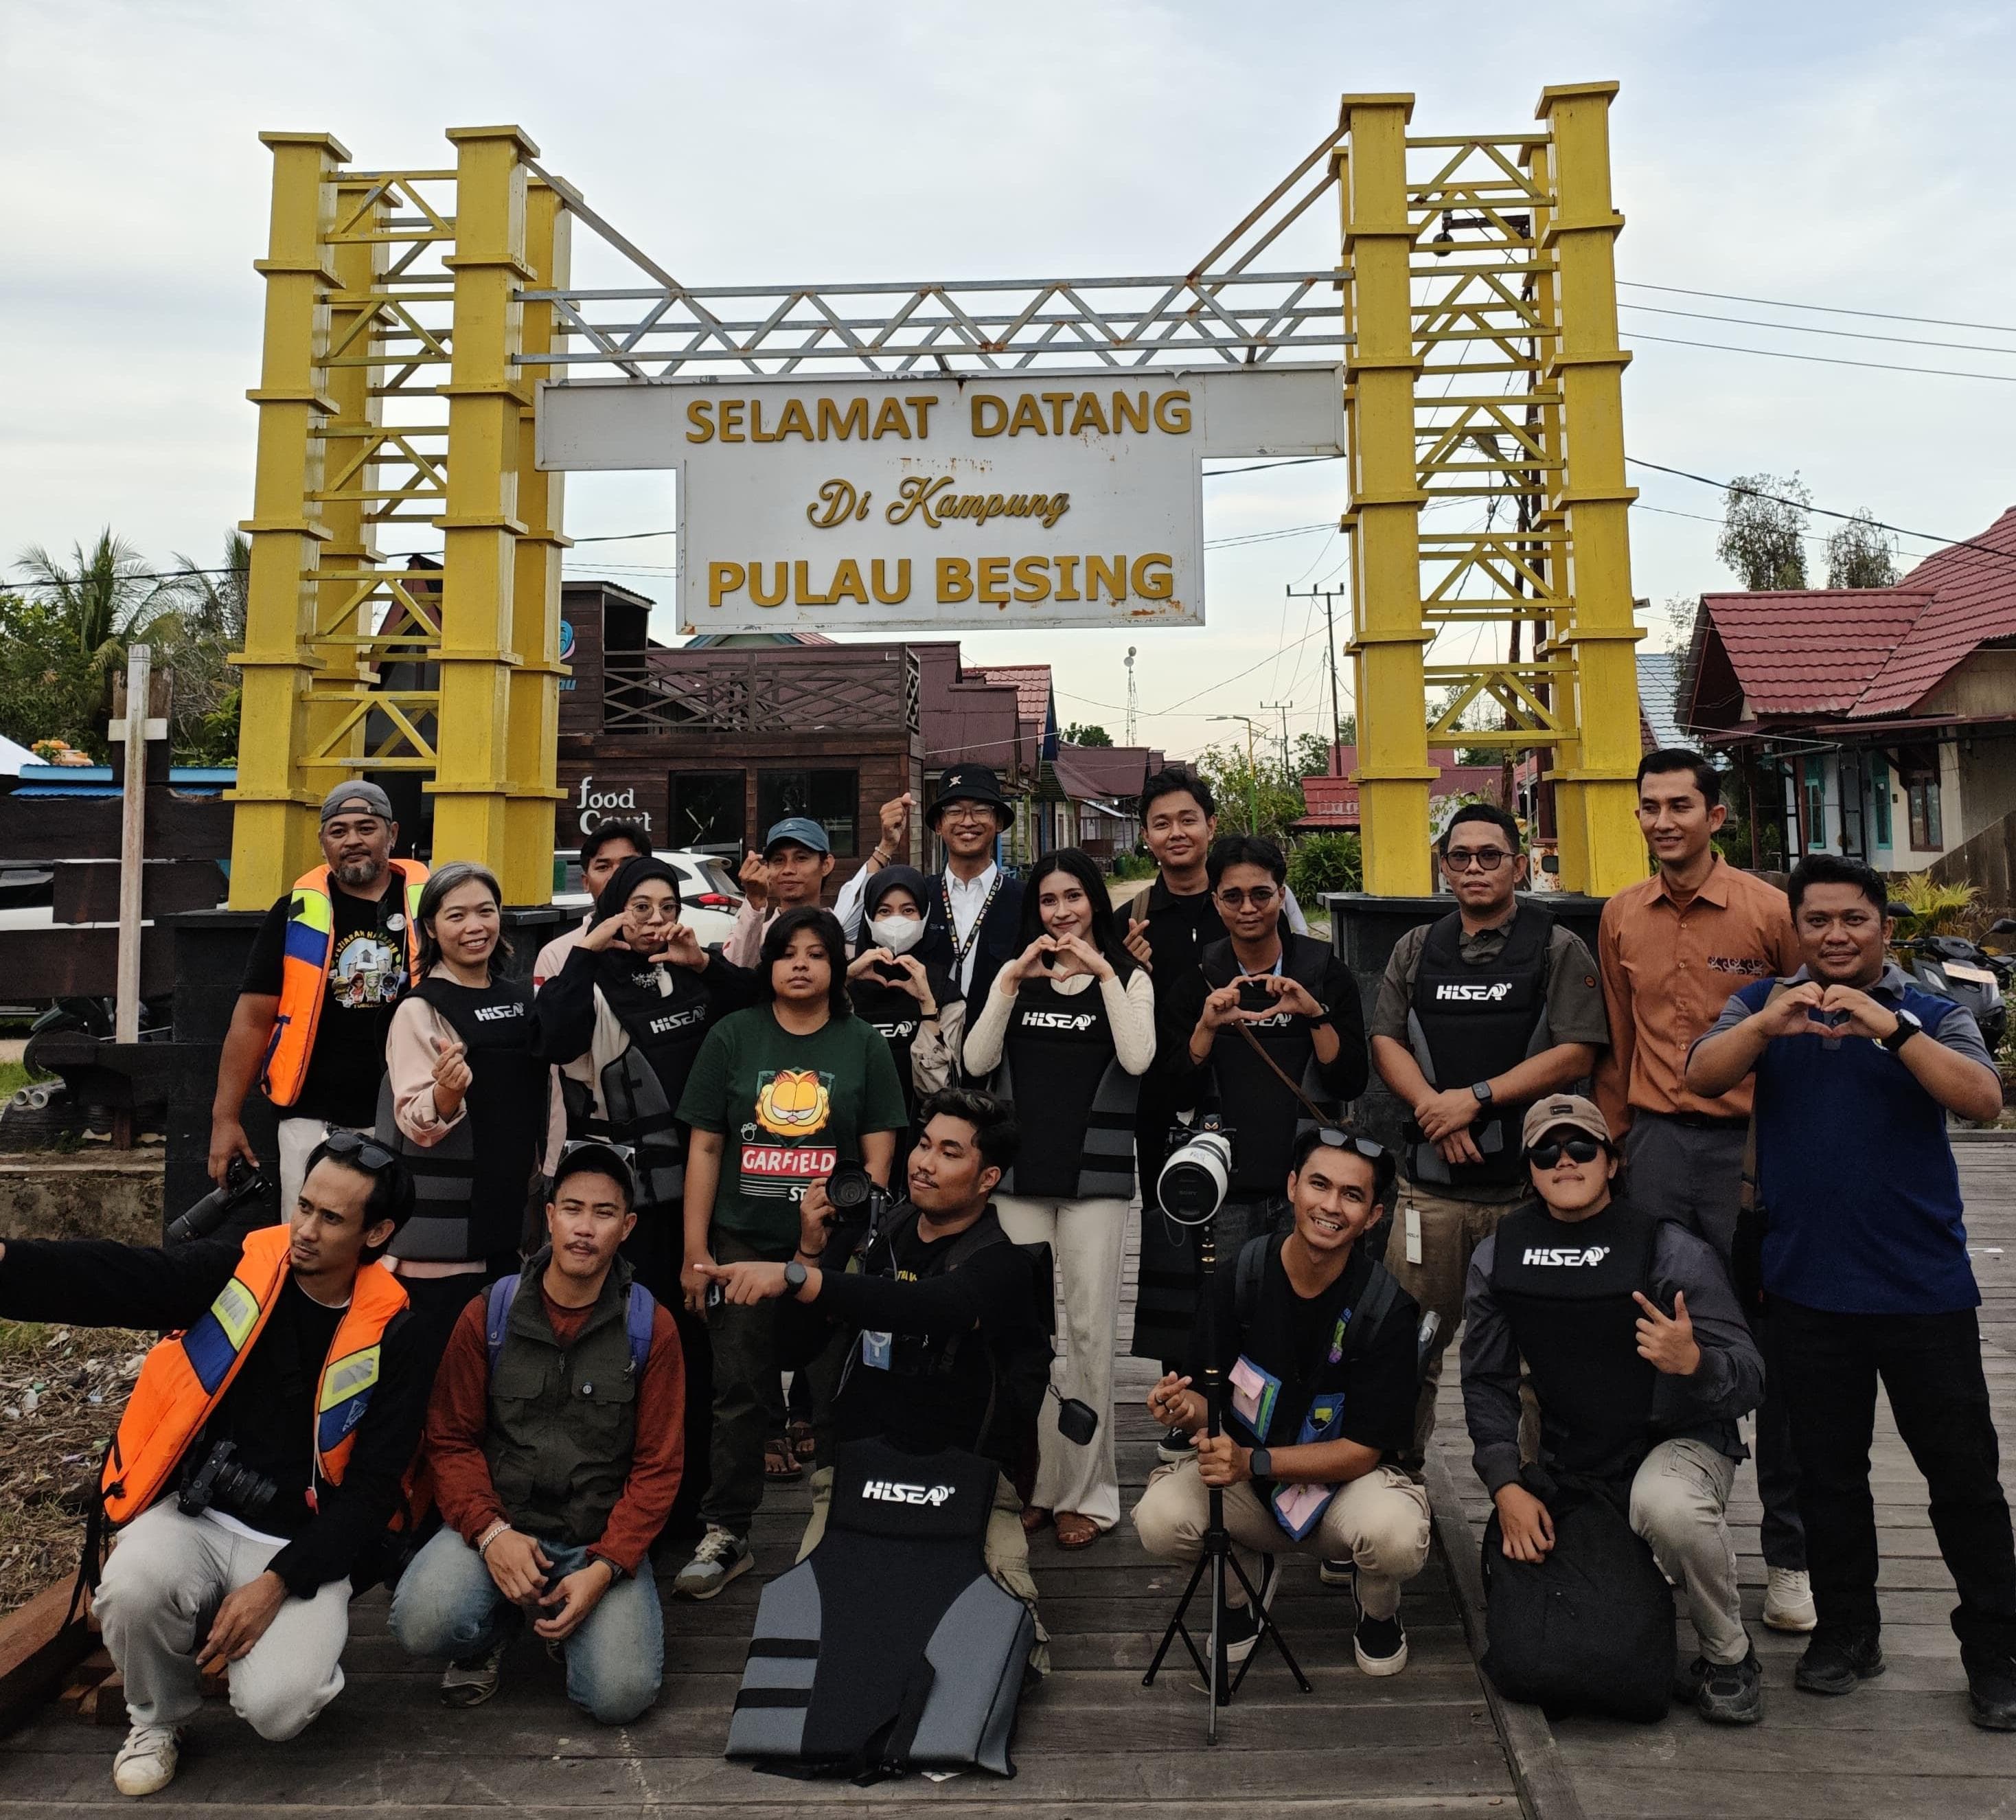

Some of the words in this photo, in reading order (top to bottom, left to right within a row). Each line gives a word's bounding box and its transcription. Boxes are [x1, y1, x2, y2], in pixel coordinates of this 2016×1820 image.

[686, 396, 939, 443] SELAMAT
[971, 390, 1192, 437] DATANG
[807, 479, 871, 528] Di
[886, 476, 1070, 529] Kampung
[709, 558, 911, 607] PULAU
[936, 553, 1173, 604] BESING
[577, 775, 636, 809] food
[742, 1150, 836, 1174] GARFIELD
